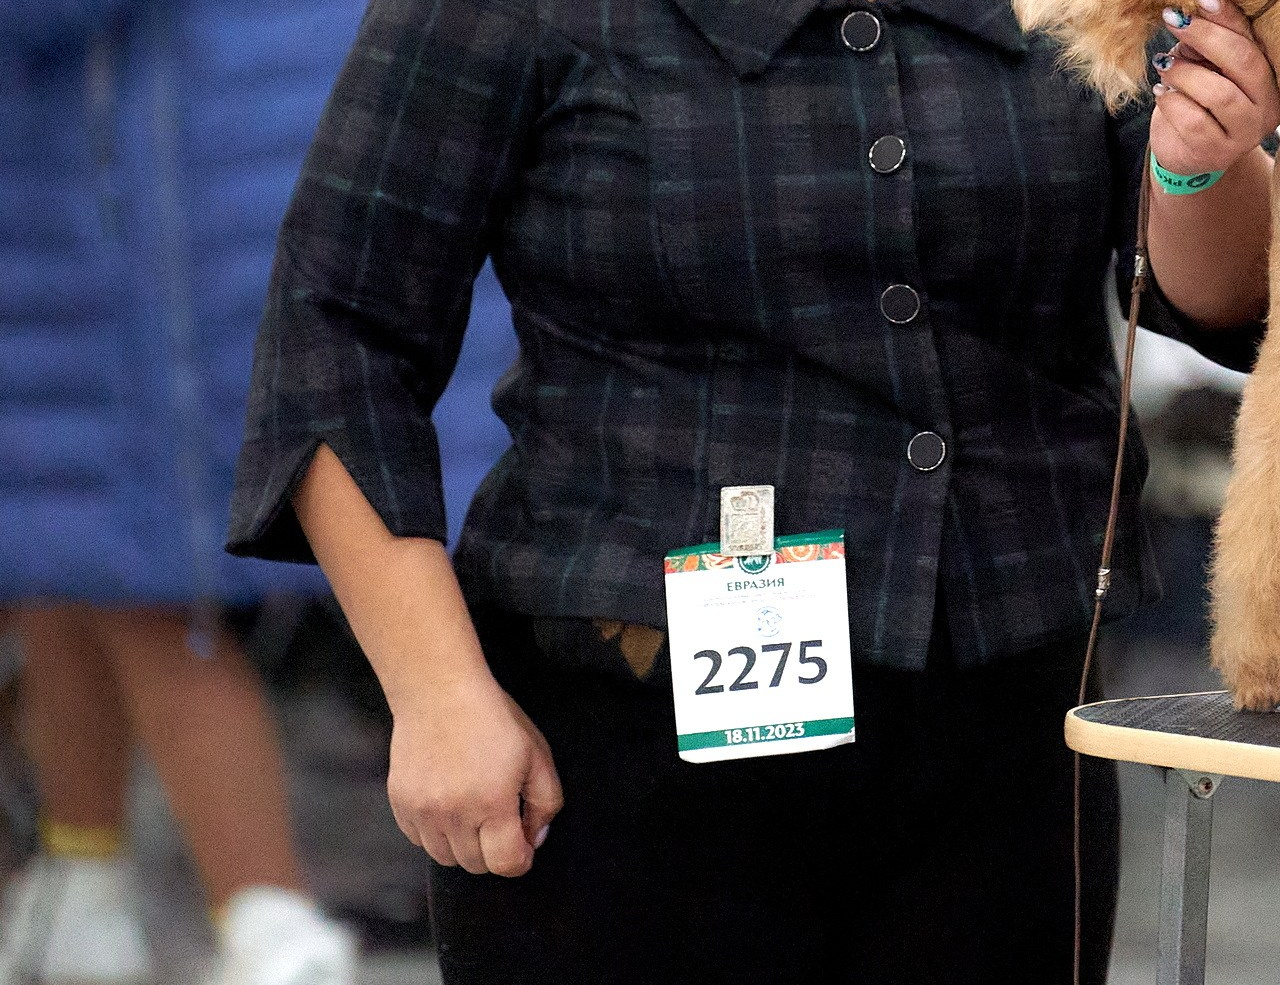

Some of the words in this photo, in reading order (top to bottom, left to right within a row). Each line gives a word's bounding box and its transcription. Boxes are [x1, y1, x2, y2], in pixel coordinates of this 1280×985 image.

[727, 577, 785, 592] ЕВРАЗИЯ
[693, 639, 828, 695] 2275
[724, 722, 805, 744] 18.11.2023
